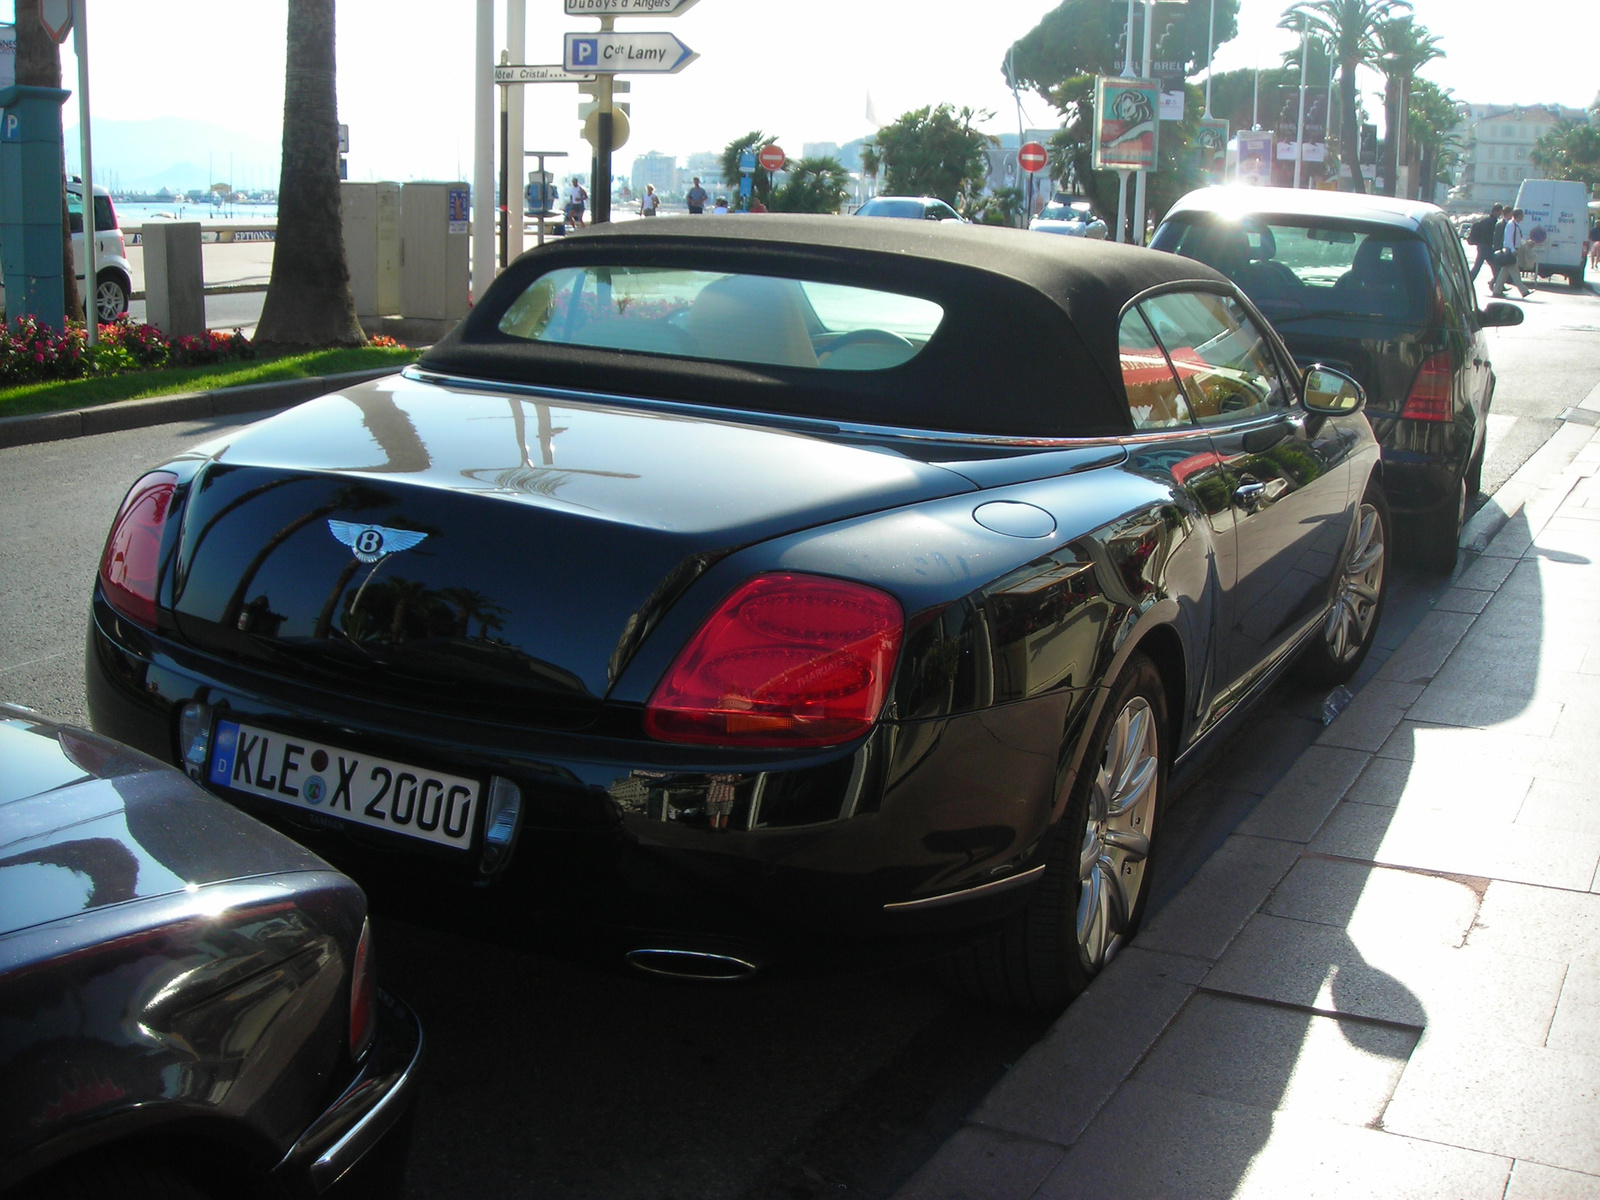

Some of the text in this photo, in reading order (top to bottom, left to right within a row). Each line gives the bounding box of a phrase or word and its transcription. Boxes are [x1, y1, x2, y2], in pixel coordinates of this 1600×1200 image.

[568, 0, 617, 10] Duboys
[578, 43, 592, 62] P
[627, 45, 667, 62] Lamy
[1153, 61, 1183, 70] BREL
[7, 114, 18, 138] P
[217, 759, 227, 773] D
[233, 731, 471, 839] KLE X 2000
